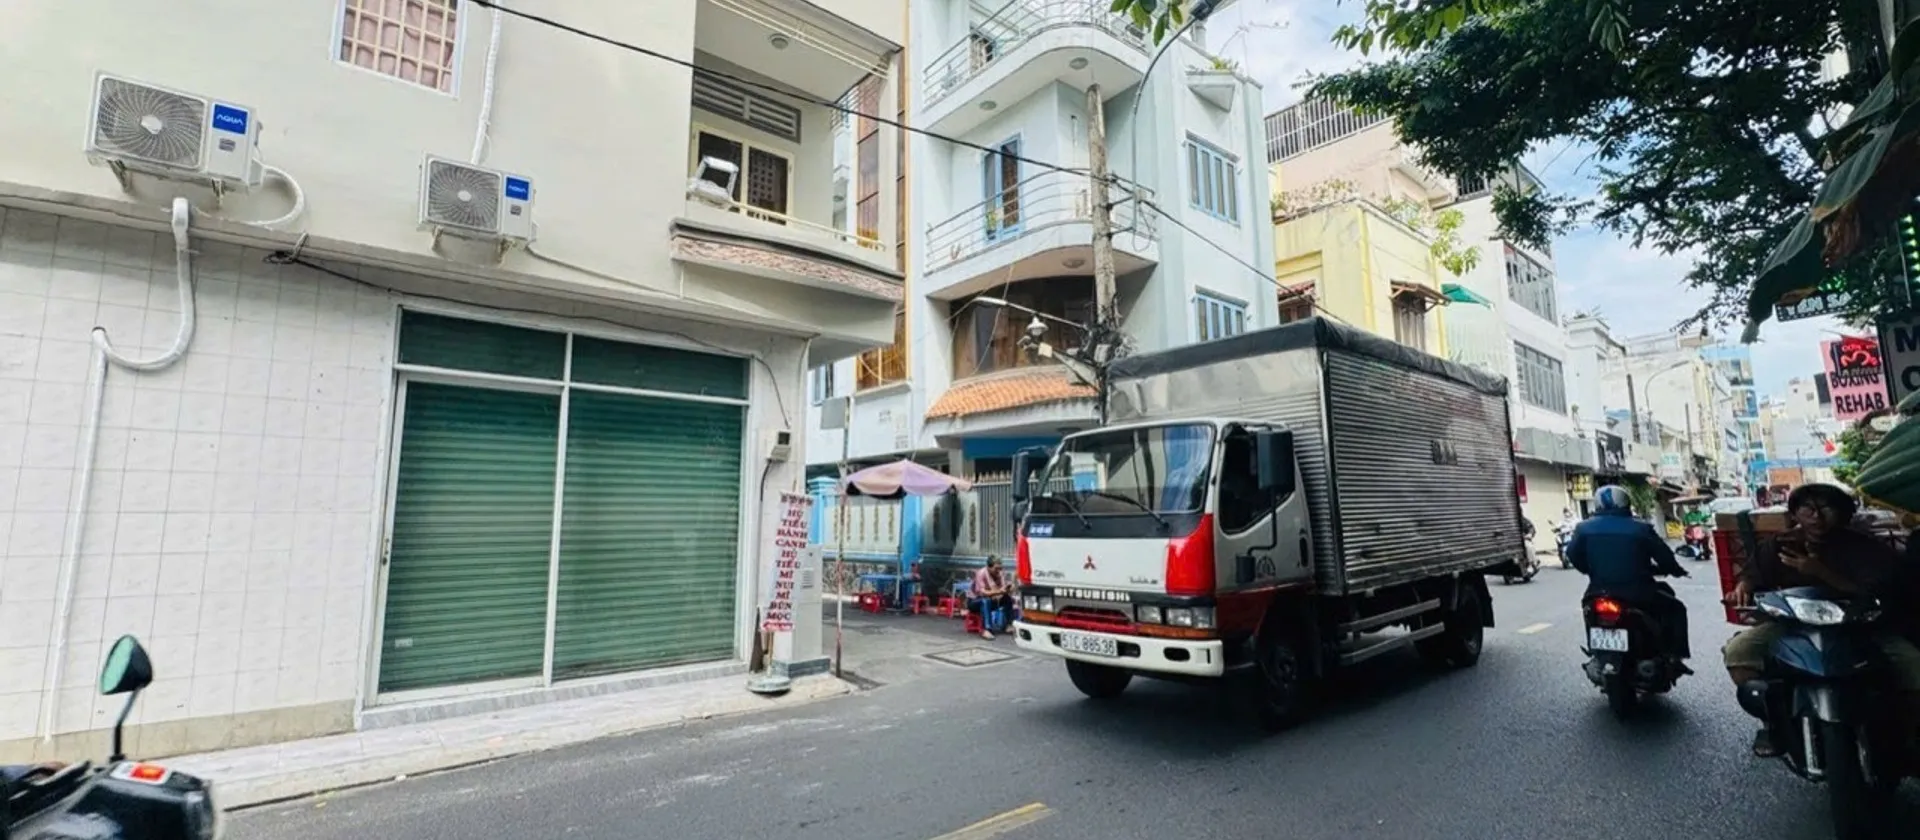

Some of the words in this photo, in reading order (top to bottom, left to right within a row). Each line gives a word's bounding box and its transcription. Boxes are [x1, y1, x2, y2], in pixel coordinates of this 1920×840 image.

[216, 114, 244, 127] AQUA
[1835, 392, 1885, 413] REHAB
[775, 539, 806, 549] CANH
[776, 580, 795, 590] NUI
[1054, 587, 1131, 602] MITSUBISHI
